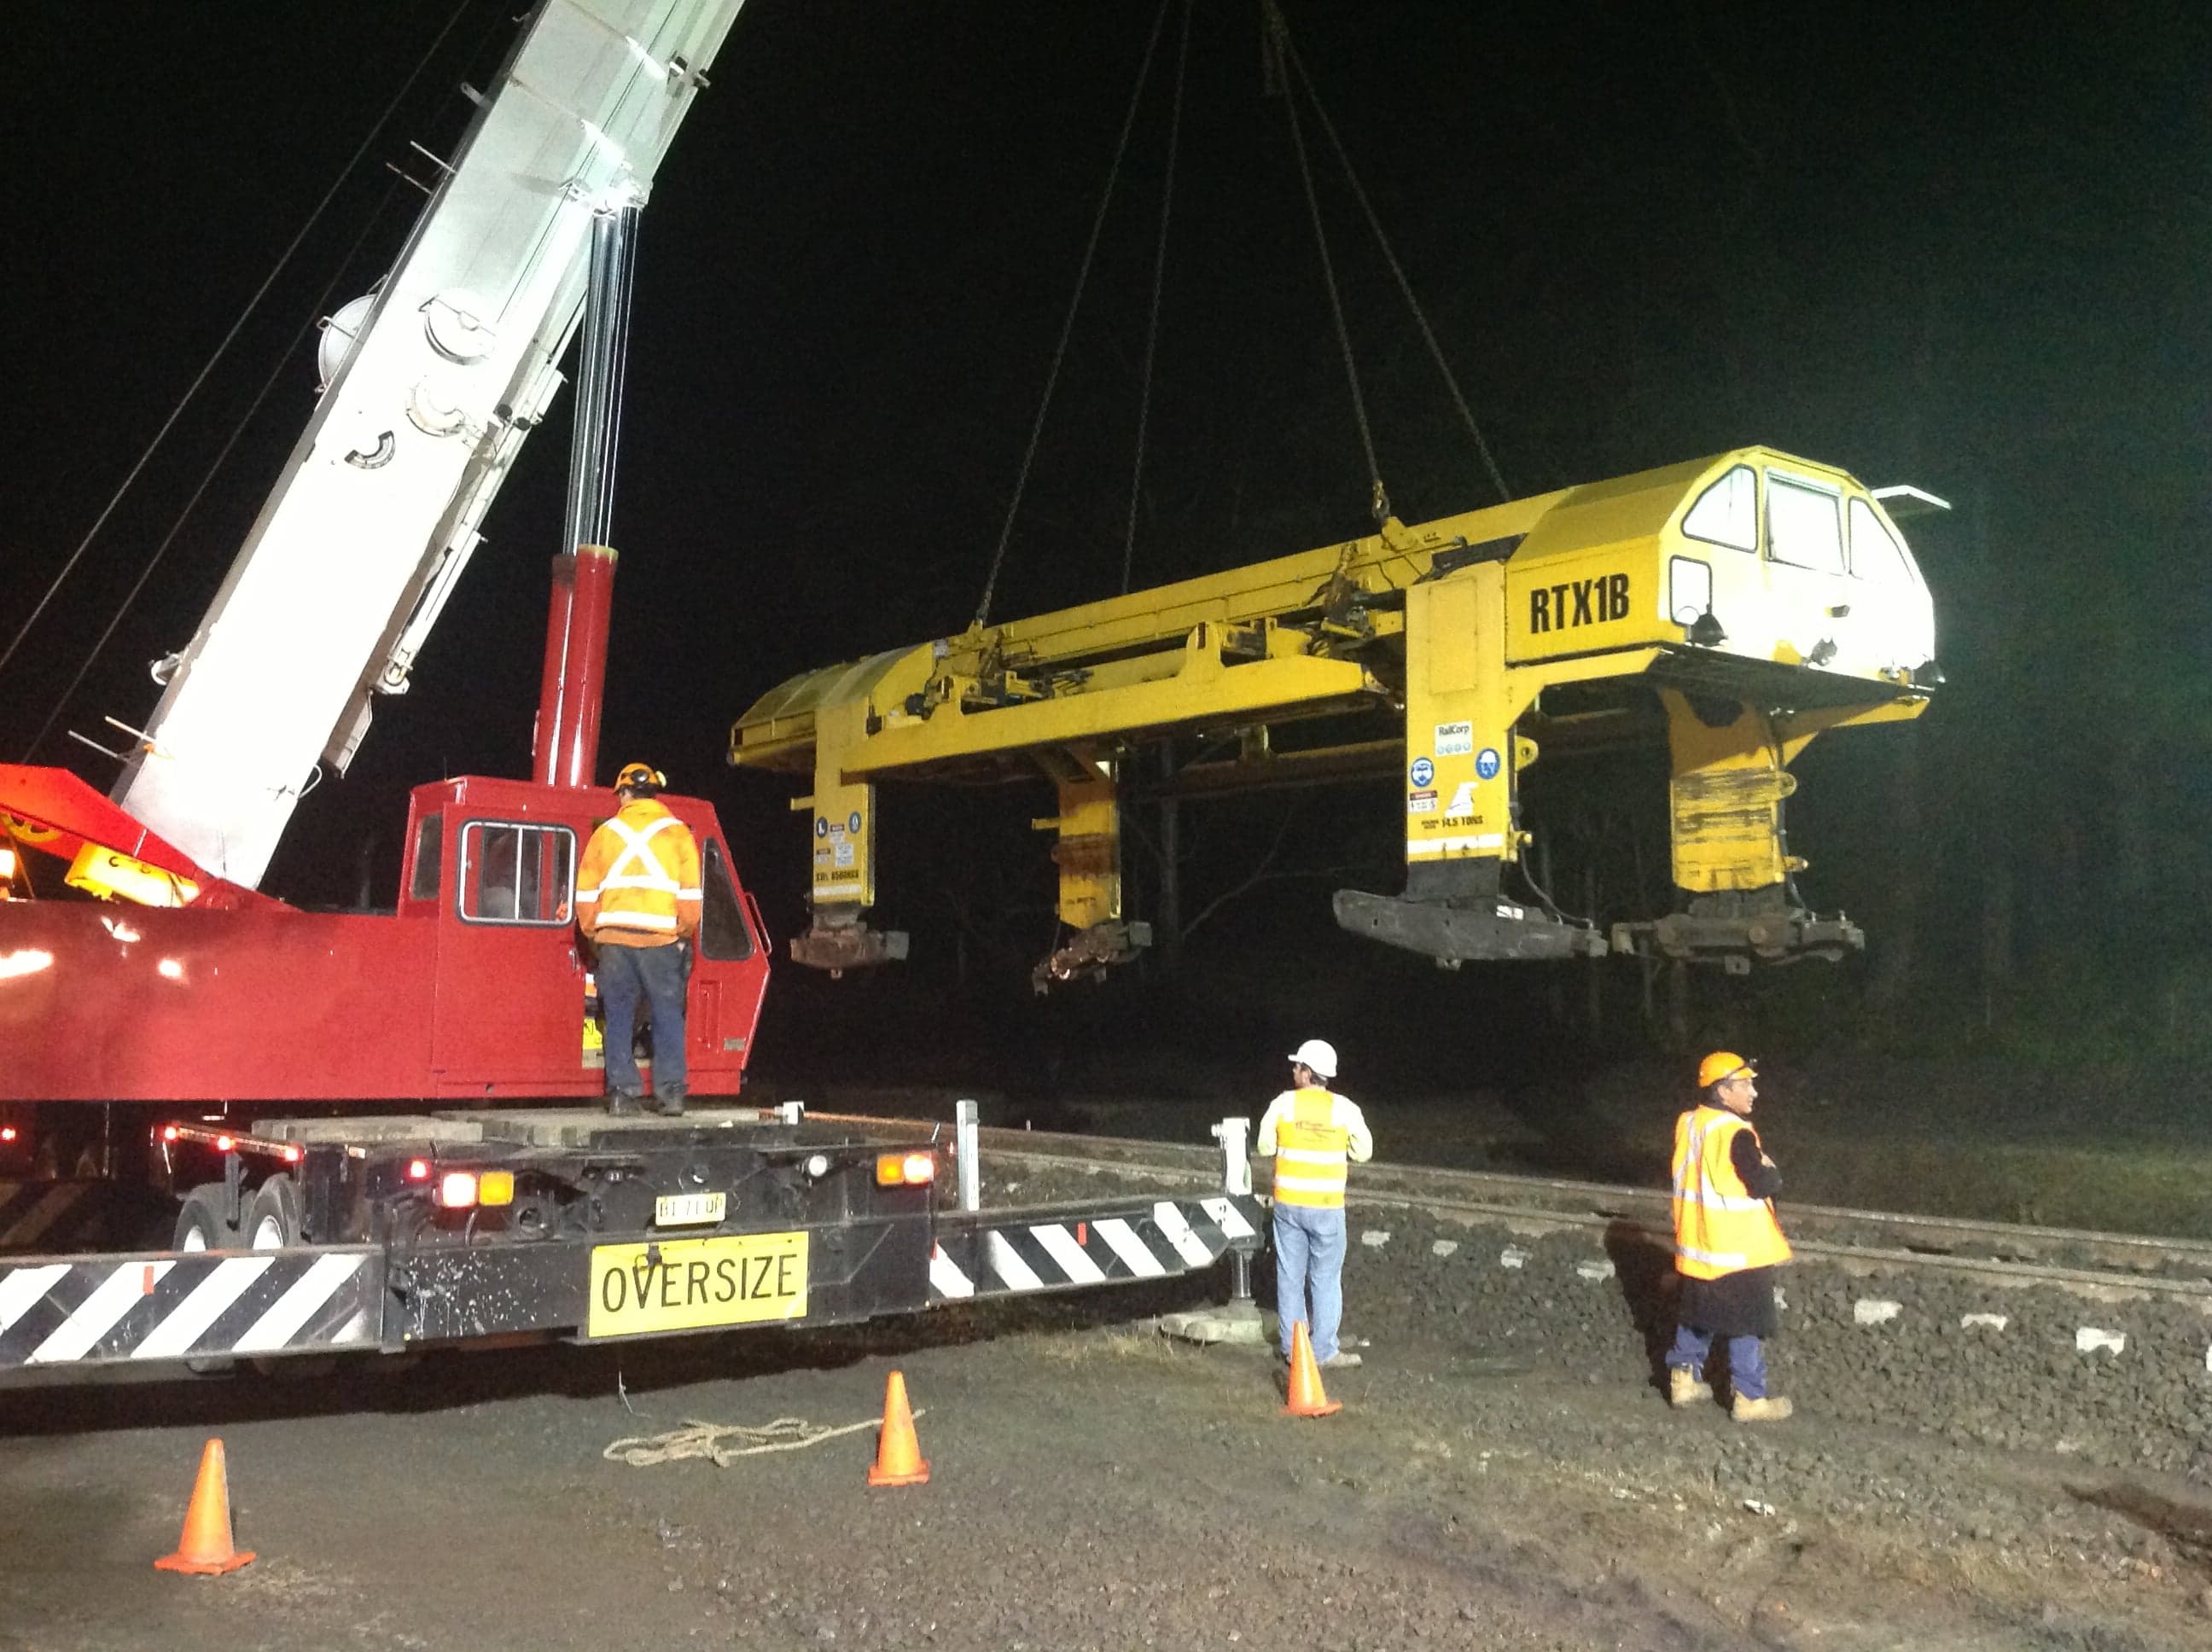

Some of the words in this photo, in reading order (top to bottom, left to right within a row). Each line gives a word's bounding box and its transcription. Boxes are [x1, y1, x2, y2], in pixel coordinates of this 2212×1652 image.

[1530, 573, 1629, 633] RTX1B
[1438, 725, 1470, 736] RailCorp
[602, 1254, 798, 1312] OVERSIZE
